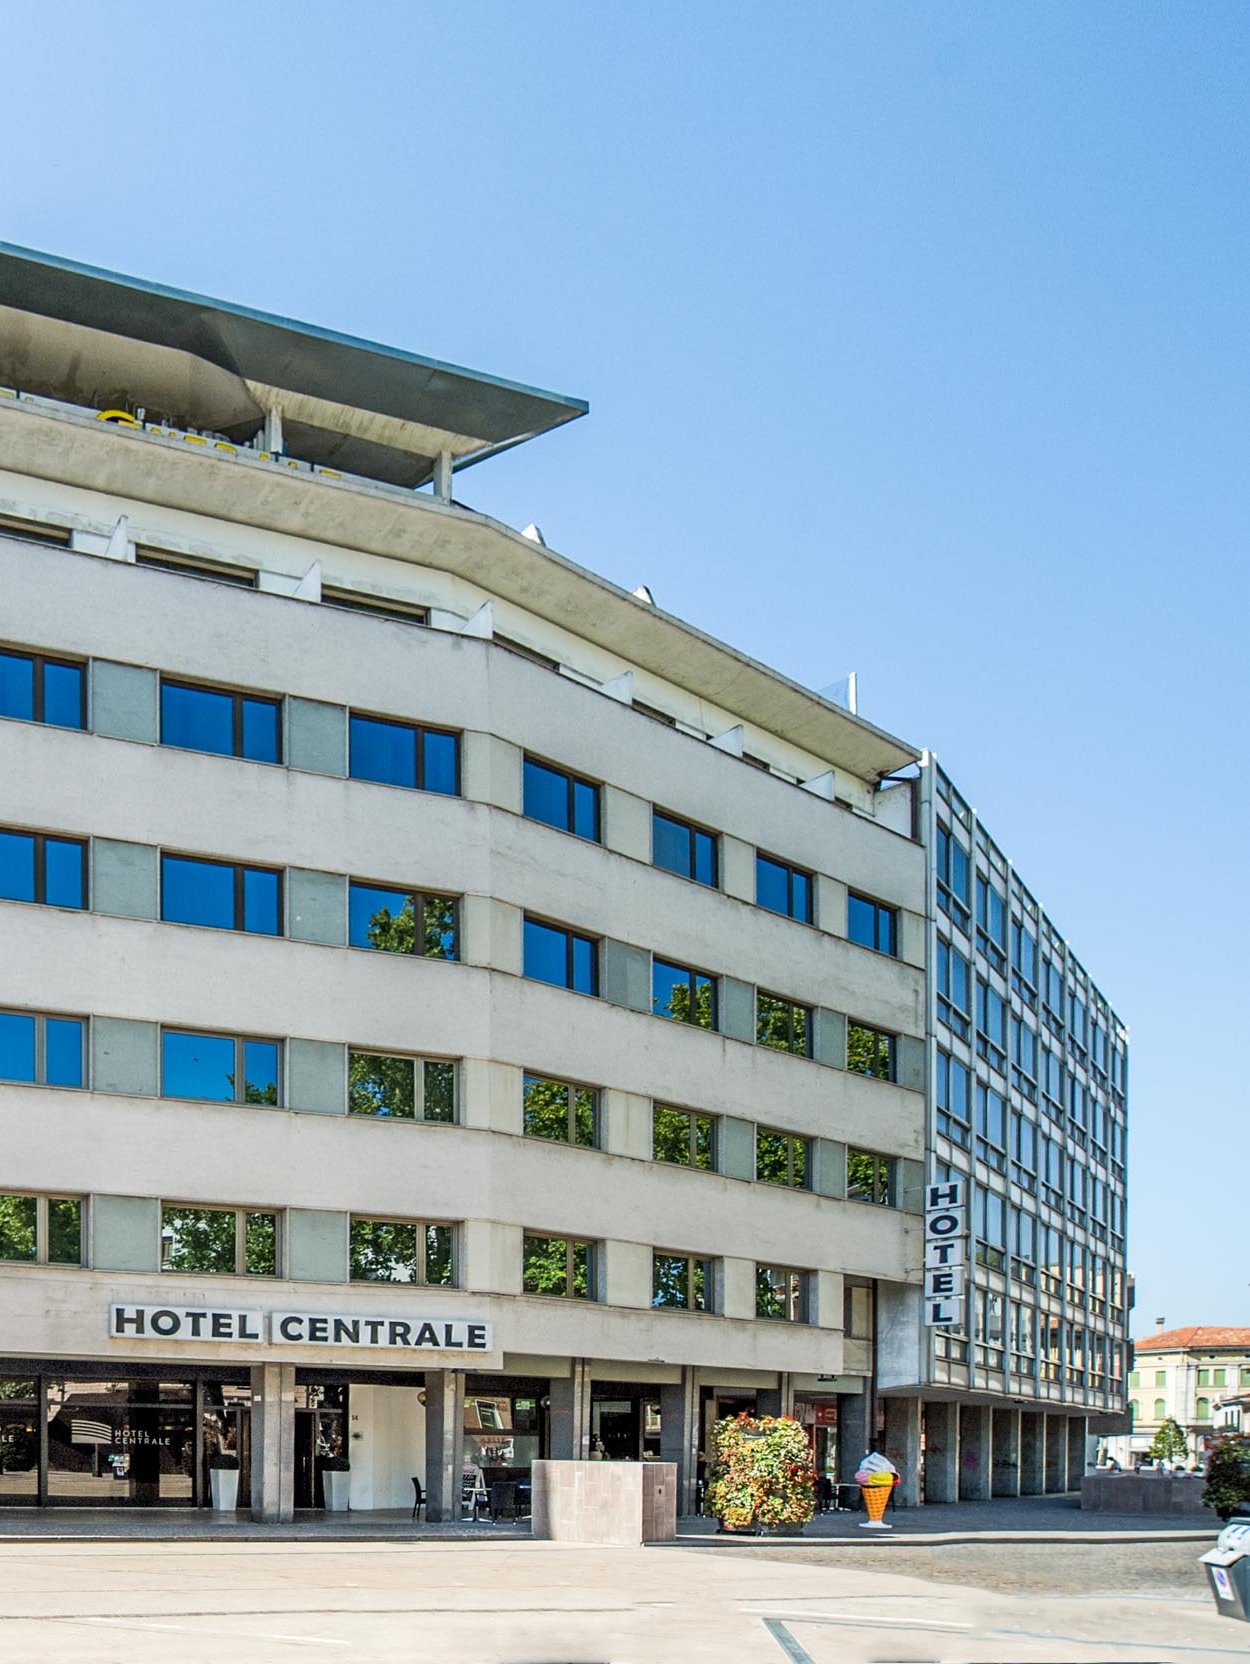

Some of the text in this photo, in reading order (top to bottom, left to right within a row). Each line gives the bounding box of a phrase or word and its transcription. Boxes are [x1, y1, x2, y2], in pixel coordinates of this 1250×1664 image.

[929, 1184, 959, 1323] HOTEL
[115, 1307, 488, 1349] HOTEL CENTRALE
[114, 1429, 150, 1438] HOTEL
[114, 1437, 171, 1446] CENTRALE
